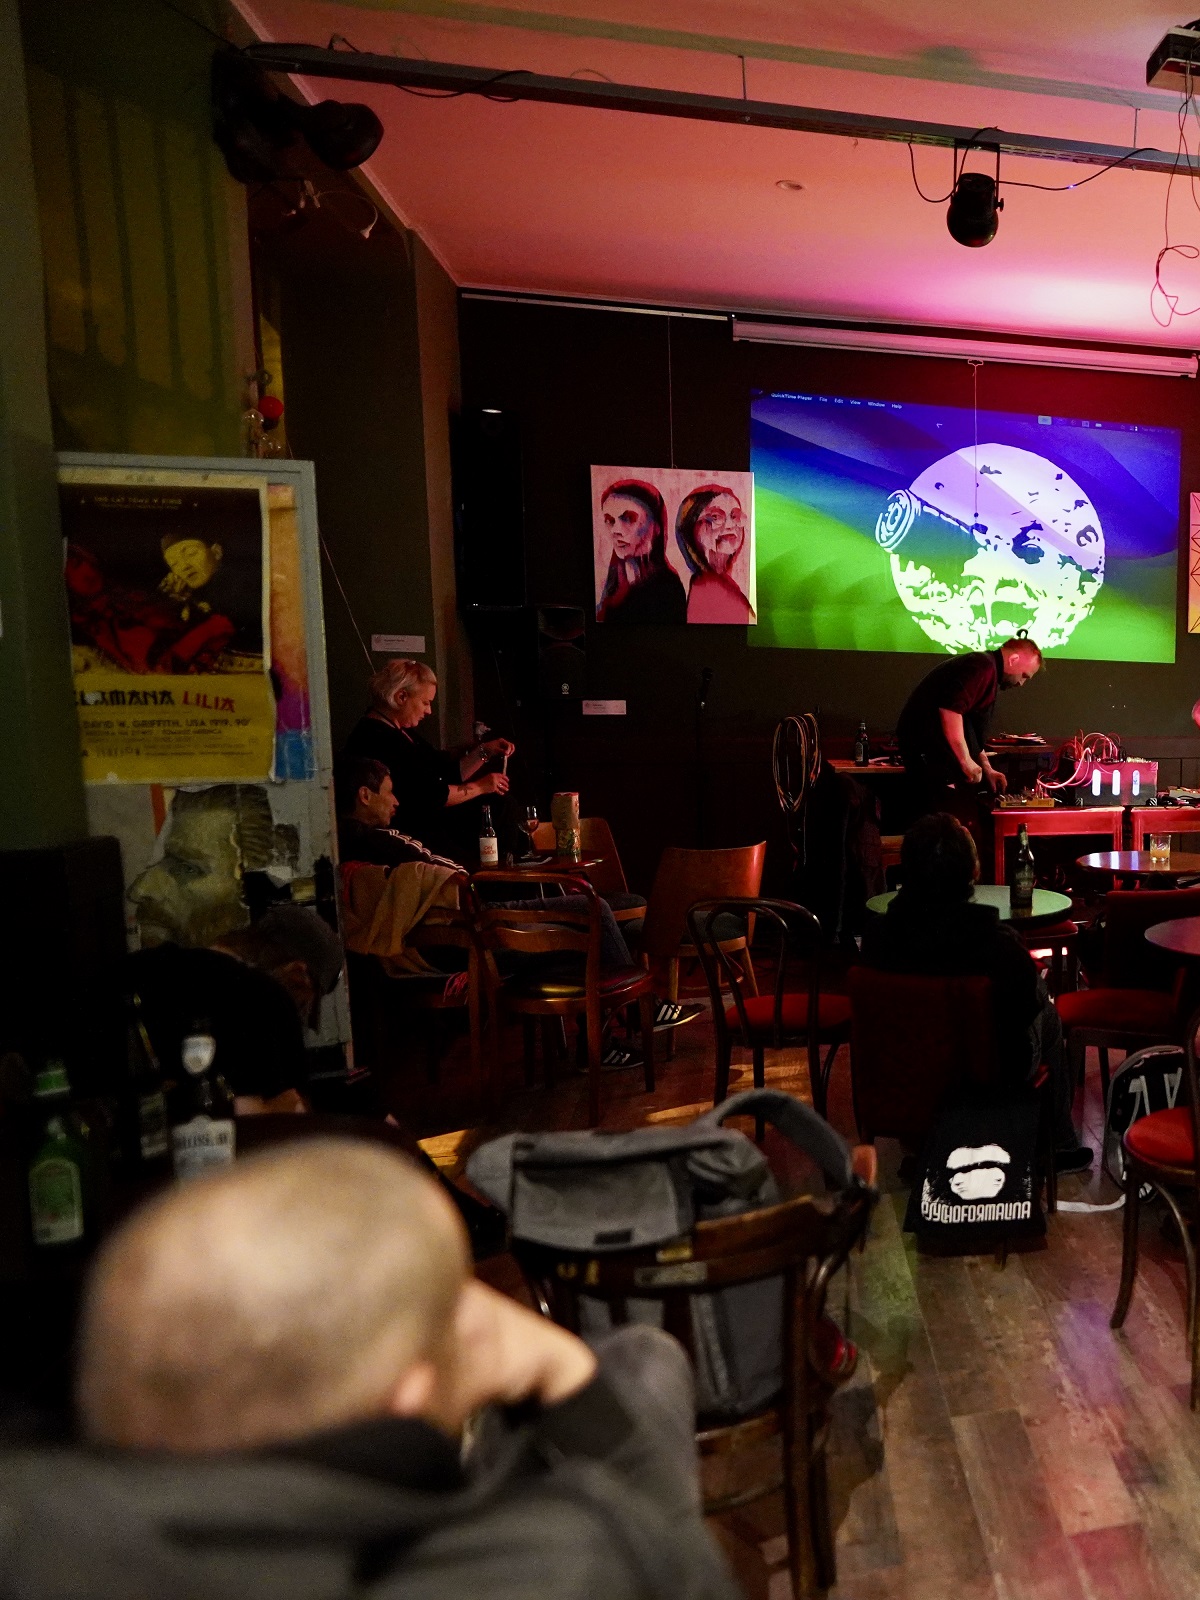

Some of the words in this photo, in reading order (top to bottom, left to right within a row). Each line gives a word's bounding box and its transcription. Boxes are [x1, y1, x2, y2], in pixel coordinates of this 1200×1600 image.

[770, 392, 797, 400] QuickTime
[182, 690, 235, 713] LILIA
[186, 719, 205, 727] USA
